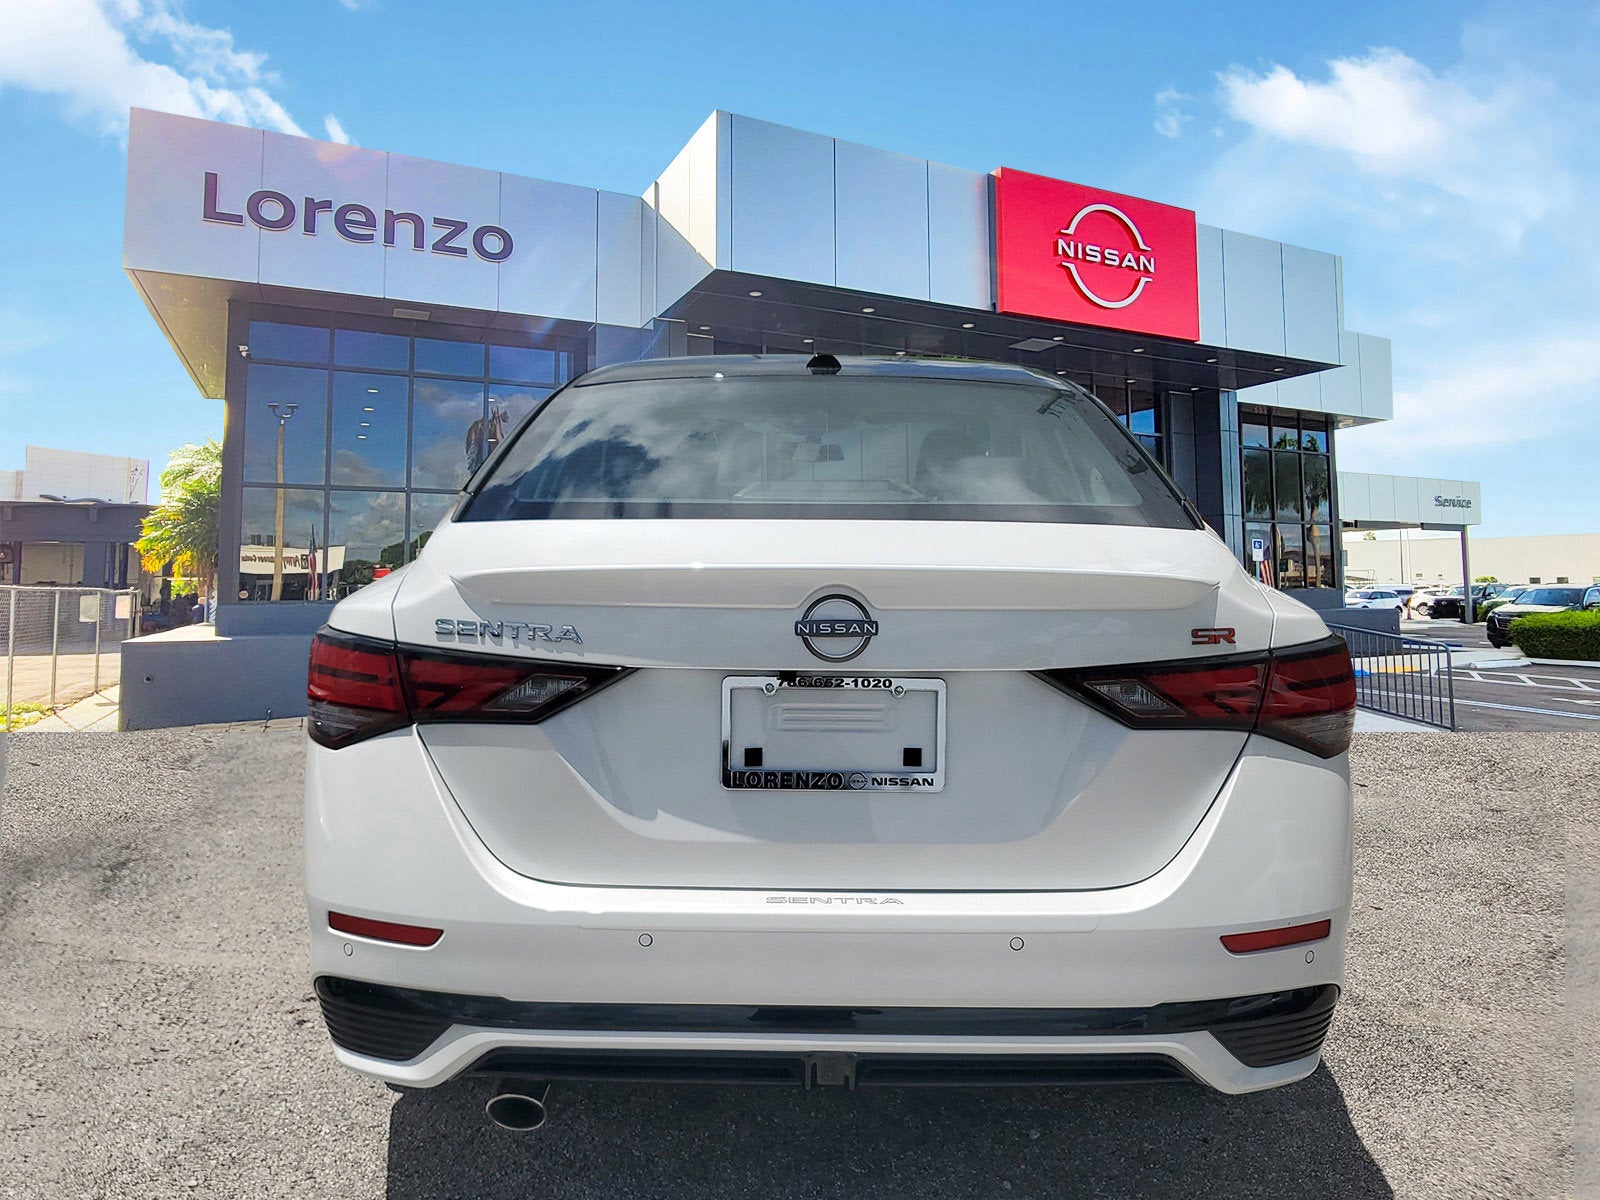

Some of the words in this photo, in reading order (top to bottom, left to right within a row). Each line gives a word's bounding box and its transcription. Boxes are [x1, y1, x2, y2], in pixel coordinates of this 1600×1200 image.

[202, 171, 515, 263] Lorenzo
[1057, 238, 1155, 273] NISSAN
[1434, 495, 1472, 508] Service
[435, 618, 584, 644] SENTRA
[797, 623, 877, 633] NISSAN
[1191, 627, 1237, 645] SR
[731, 772, 845, 789] LORENZO
[871, 777, 935, 787] NISSAN
[766, 896, 905, 905] SENTRA
